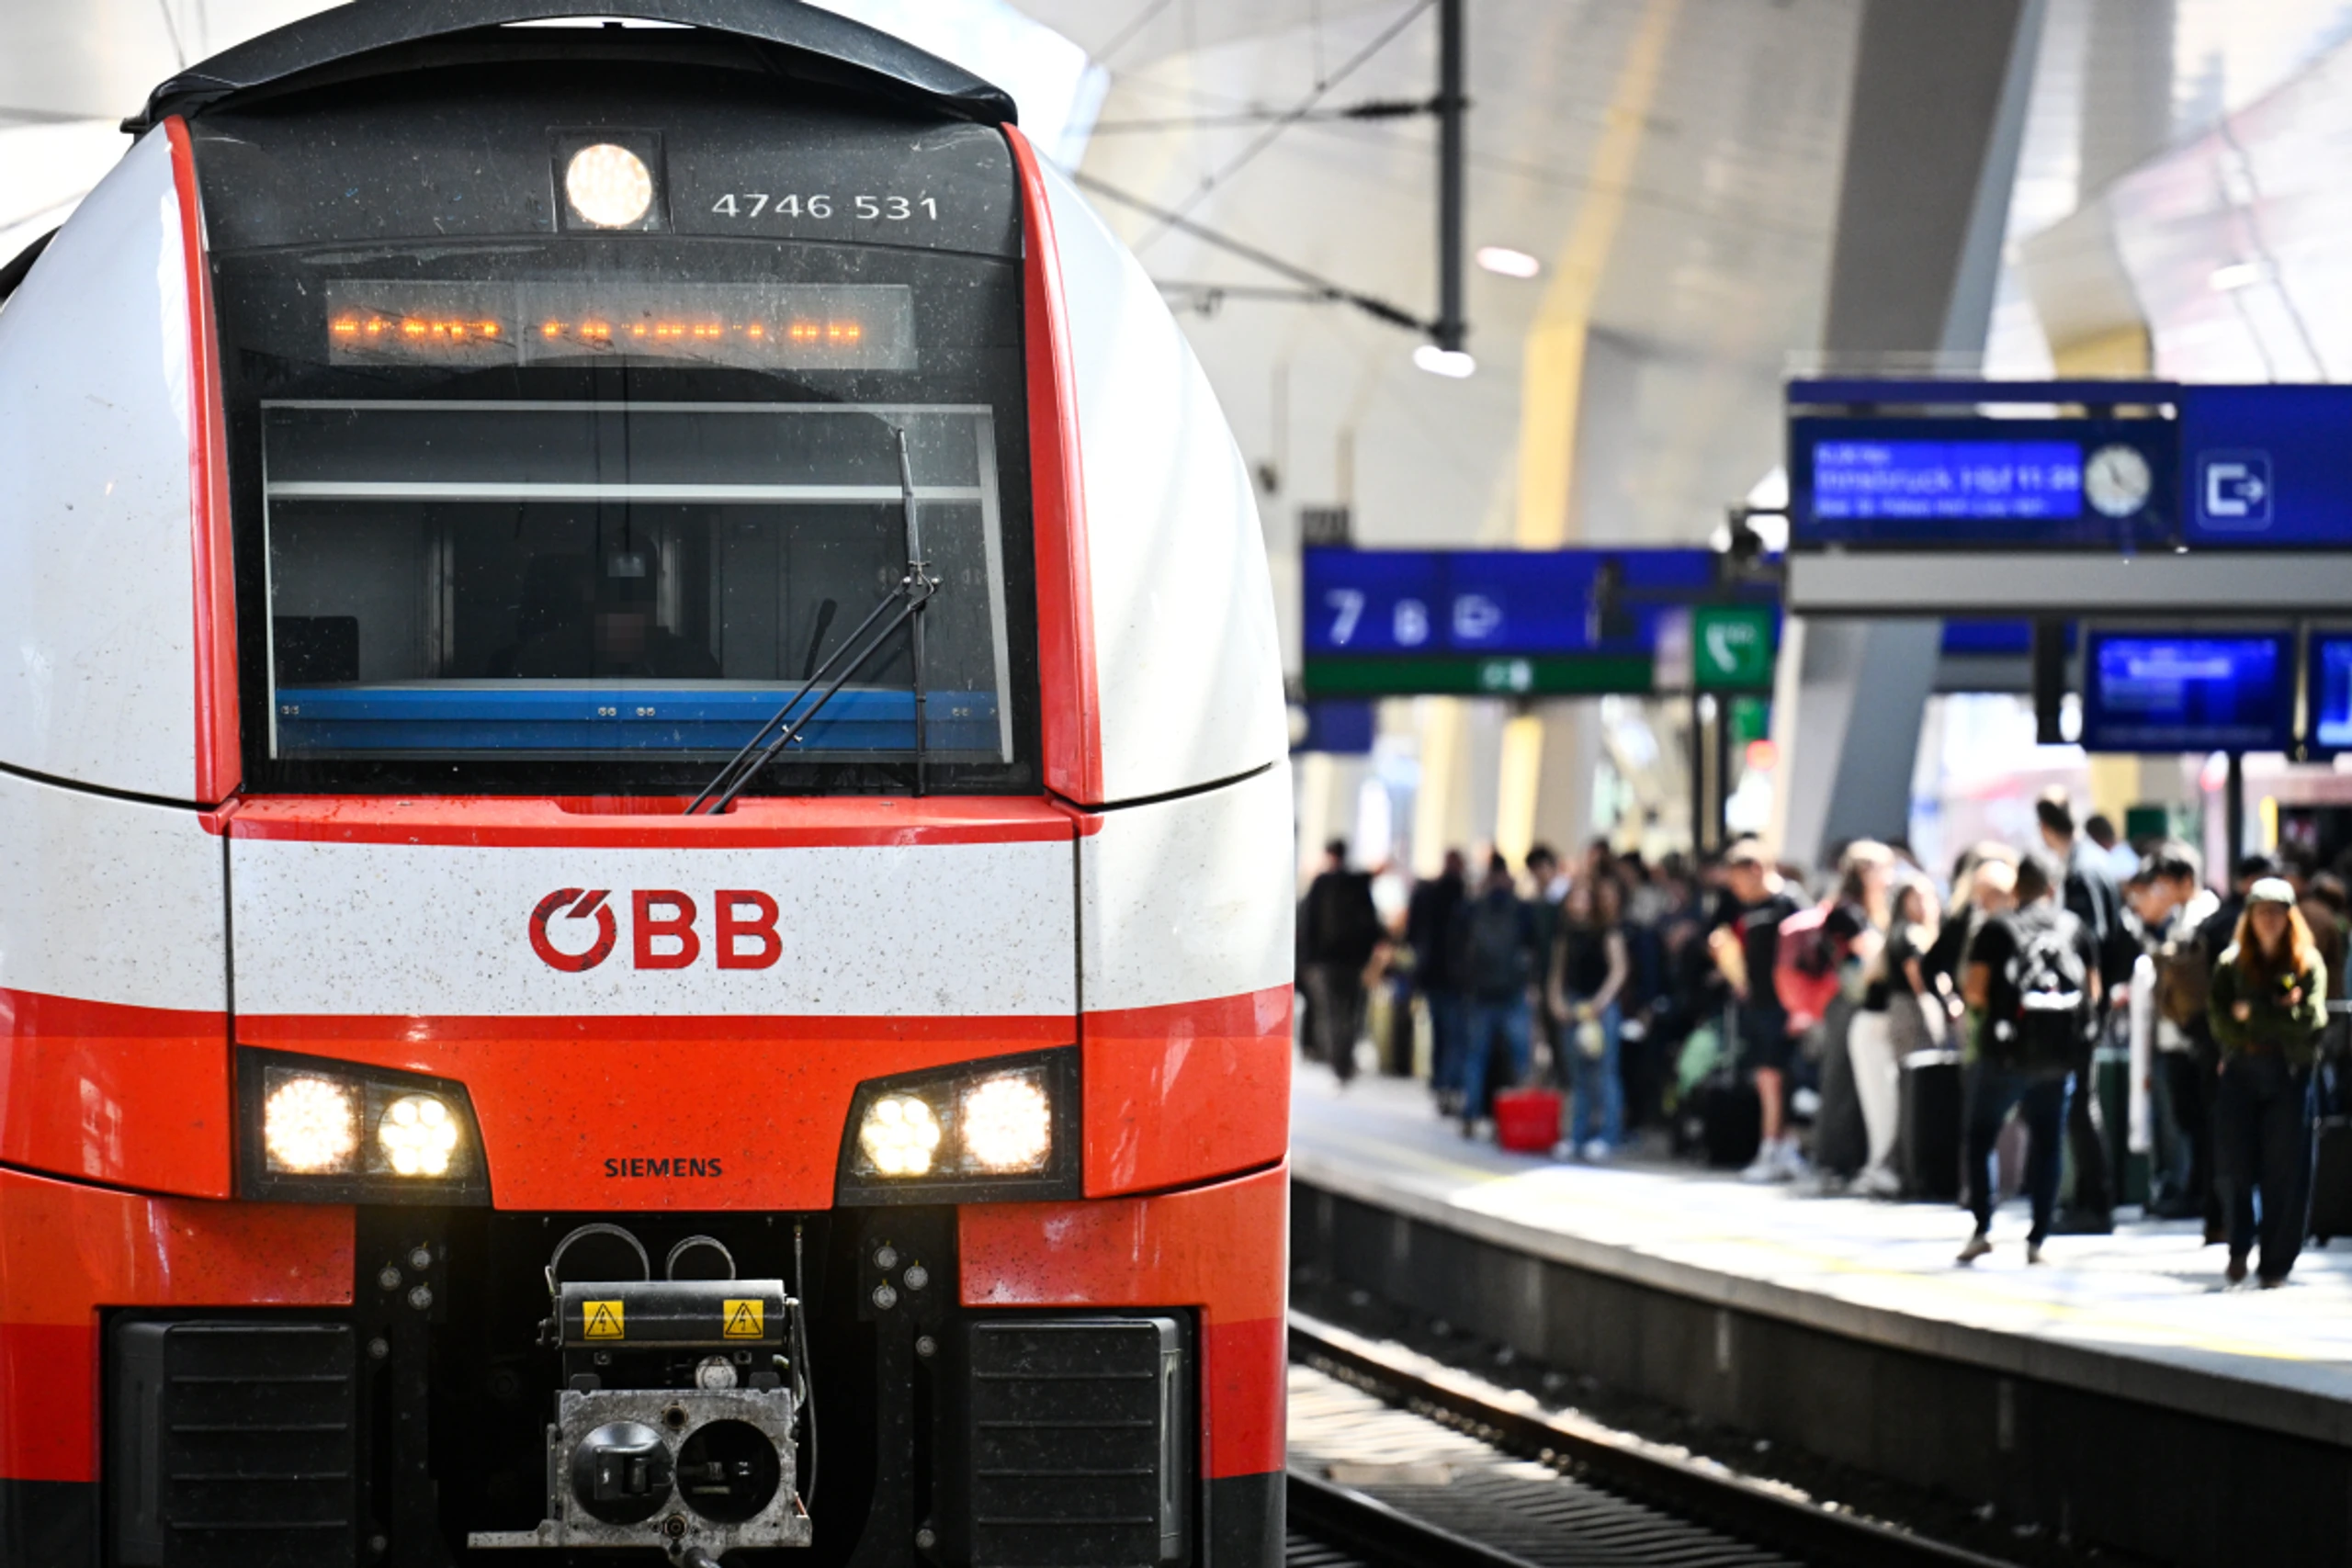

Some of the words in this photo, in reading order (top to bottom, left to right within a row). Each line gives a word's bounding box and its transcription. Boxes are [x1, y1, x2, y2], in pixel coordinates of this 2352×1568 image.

[711, 193, 833, 219] 4746
[854, 195, 938, 220] 531
[1325, 588, 1365, 645] 7
[528, 887, 783, 973] ÖBB
[604, 1158, 723, 1178] SIEMENS
